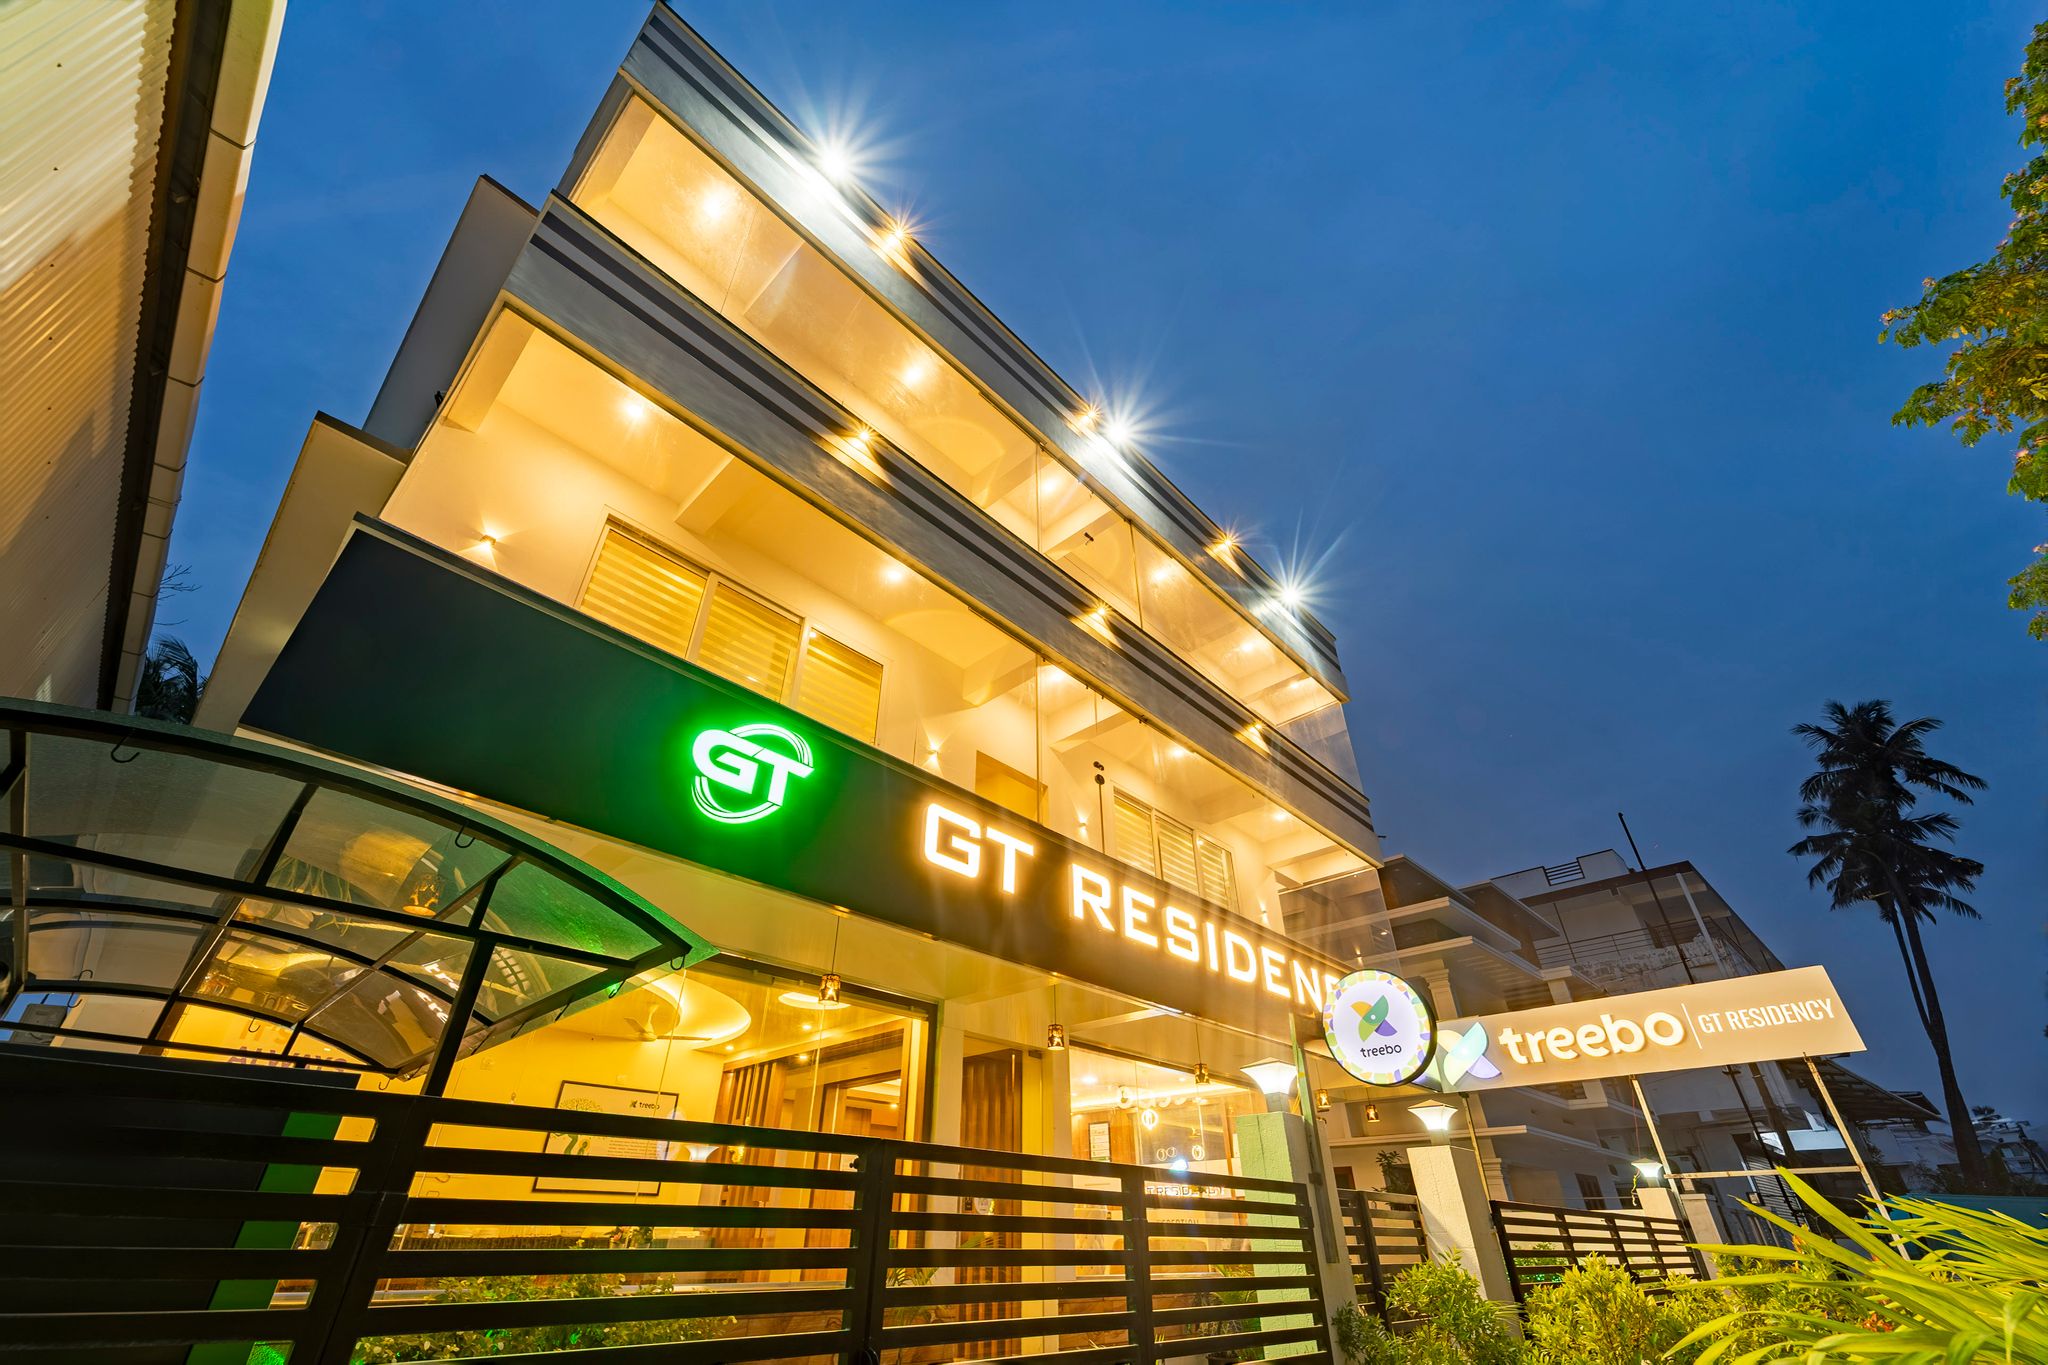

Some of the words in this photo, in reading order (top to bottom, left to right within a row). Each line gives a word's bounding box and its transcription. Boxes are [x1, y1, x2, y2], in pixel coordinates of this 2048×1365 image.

[925, 803, 1034, 894] GT
[1360, 1044, 1402, 1058] treebo
[1498, 1011, 1685, 1065] treebo
[1698, 1013, 1724, 1034] GT
[1725, 998, 1835, 1031] RESIDENCY
